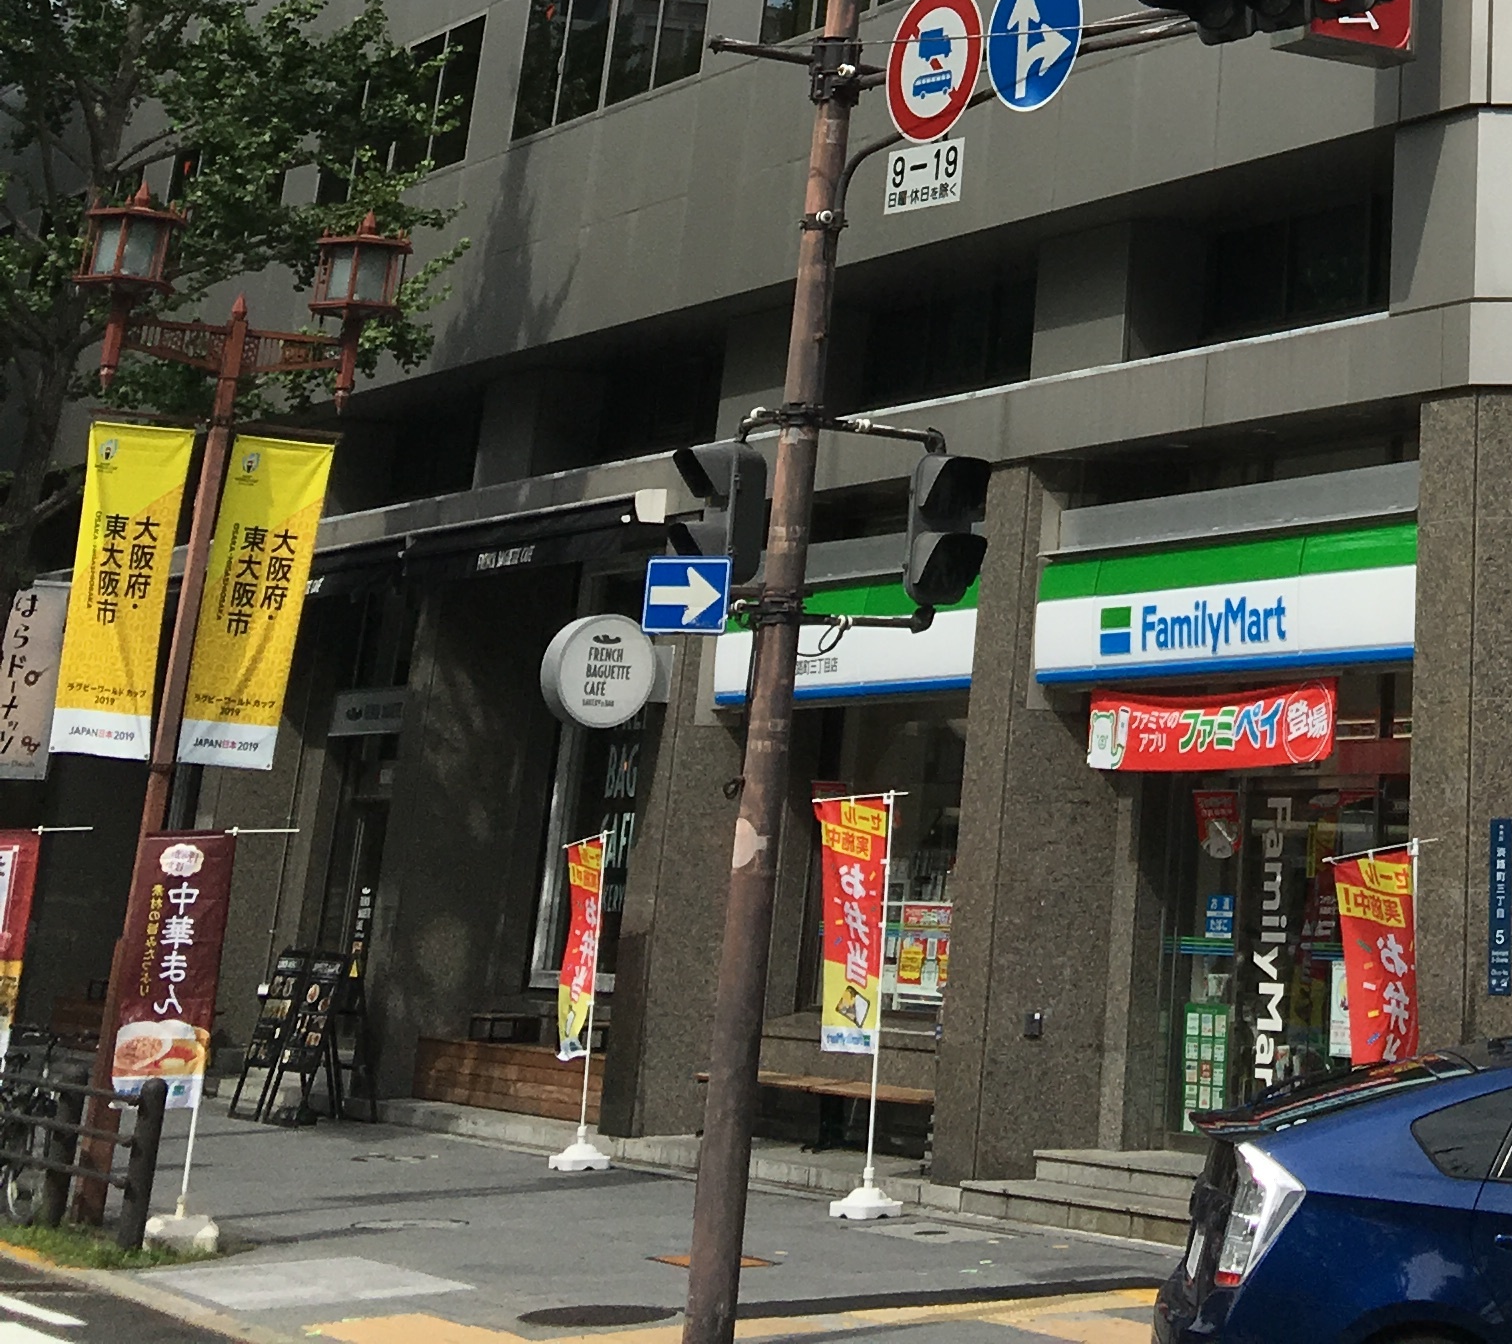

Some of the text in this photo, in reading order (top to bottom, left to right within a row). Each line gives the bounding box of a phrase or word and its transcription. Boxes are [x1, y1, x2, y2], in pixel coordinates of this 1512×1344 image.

[891, 145, 958, 189] 9-19
[96, 513, 130, 626] 東大阪市
[226, 525, 268, 636] 東大阪市
[1141, 595, 1288, 653] FamilyMart
[586, 663, 632, 680] BAGUETTE
[588, 647, 624, 662] FRENCH
[94, 695, 115, 706] 2019
[1132, 710, 1180, 730] ファミマの
[1286, 699, 1329, 742] 登場
[1138, 731, 1167, 753] アプリ
[1178, 697, 1286, 753] ファミペイ
[1253, 797, 1293, 1087] FamilyMar
[1495, 929, 1505, 944] 5
